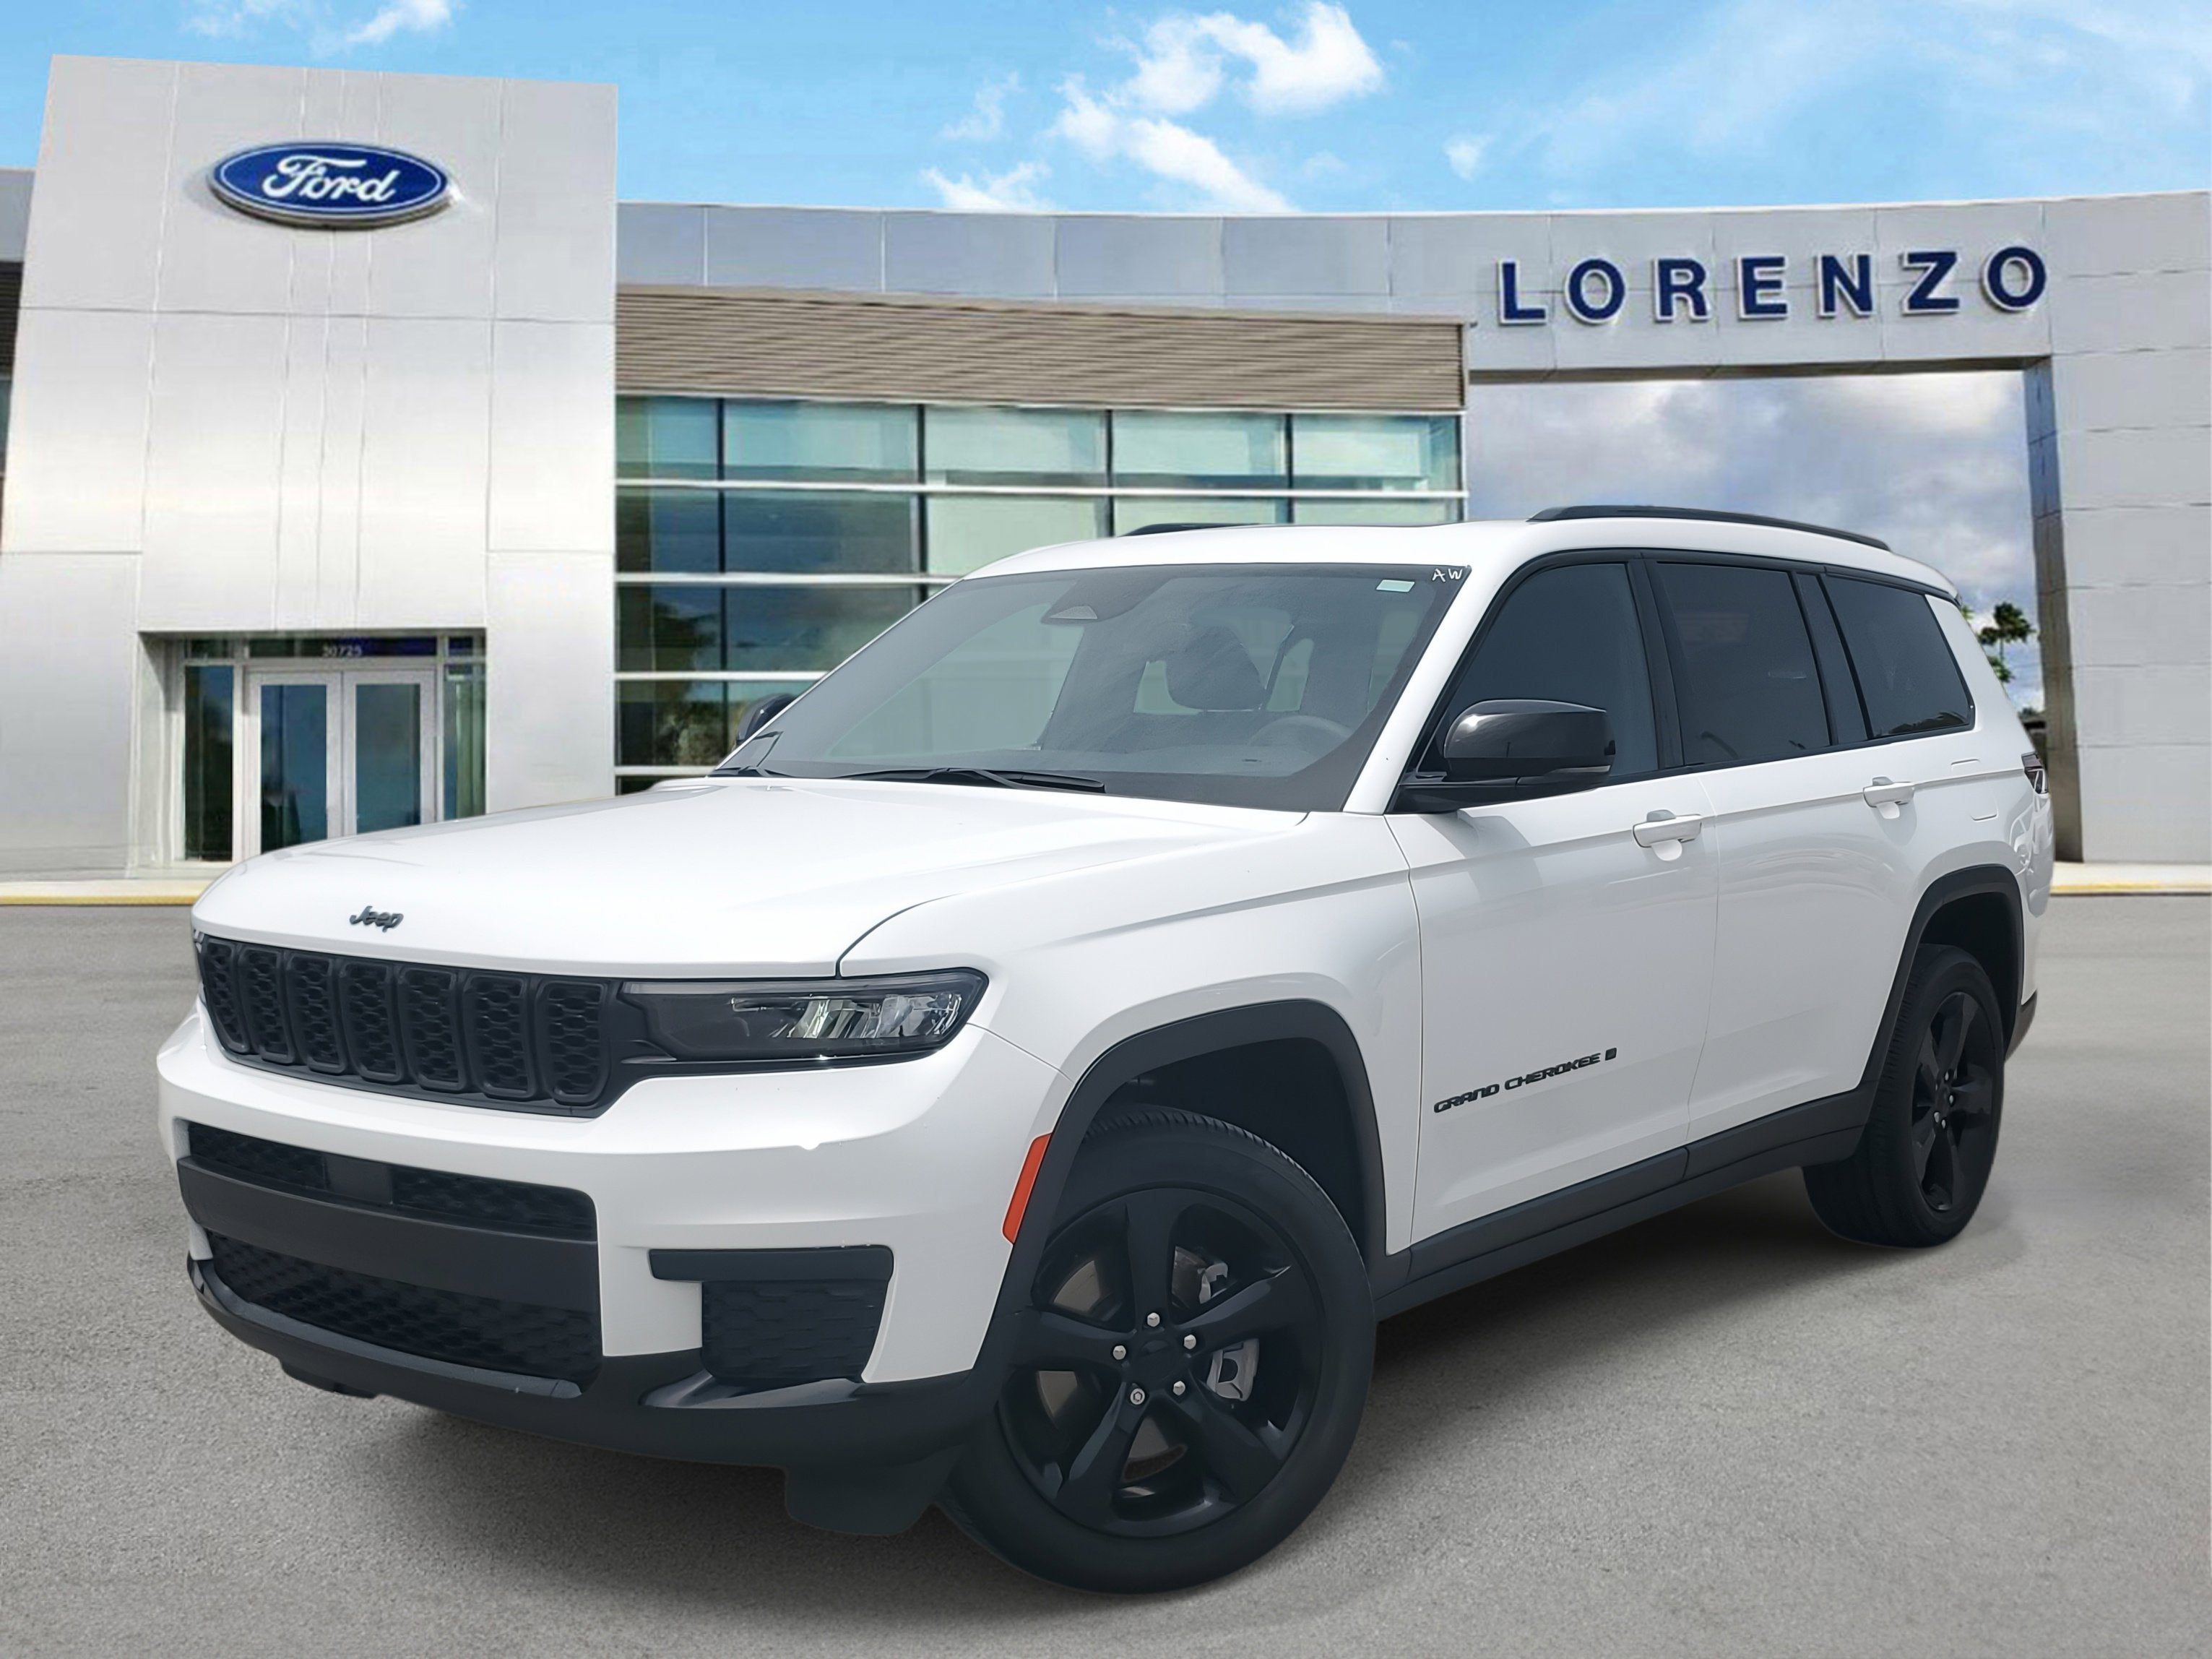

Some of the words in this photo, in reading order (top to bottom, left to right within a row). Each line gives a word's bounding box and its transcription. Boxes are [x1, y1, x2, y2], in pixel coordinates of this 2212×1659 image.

[262, 155, 401, 202] Ford
[1498, 246, 2048, 324] LORENZO
[349, 905, 404, 933] Jeep
[1433, 1083, 1500, 1113] GRAND
[1504, 1053, 1602, 1090] CHEROKEE
